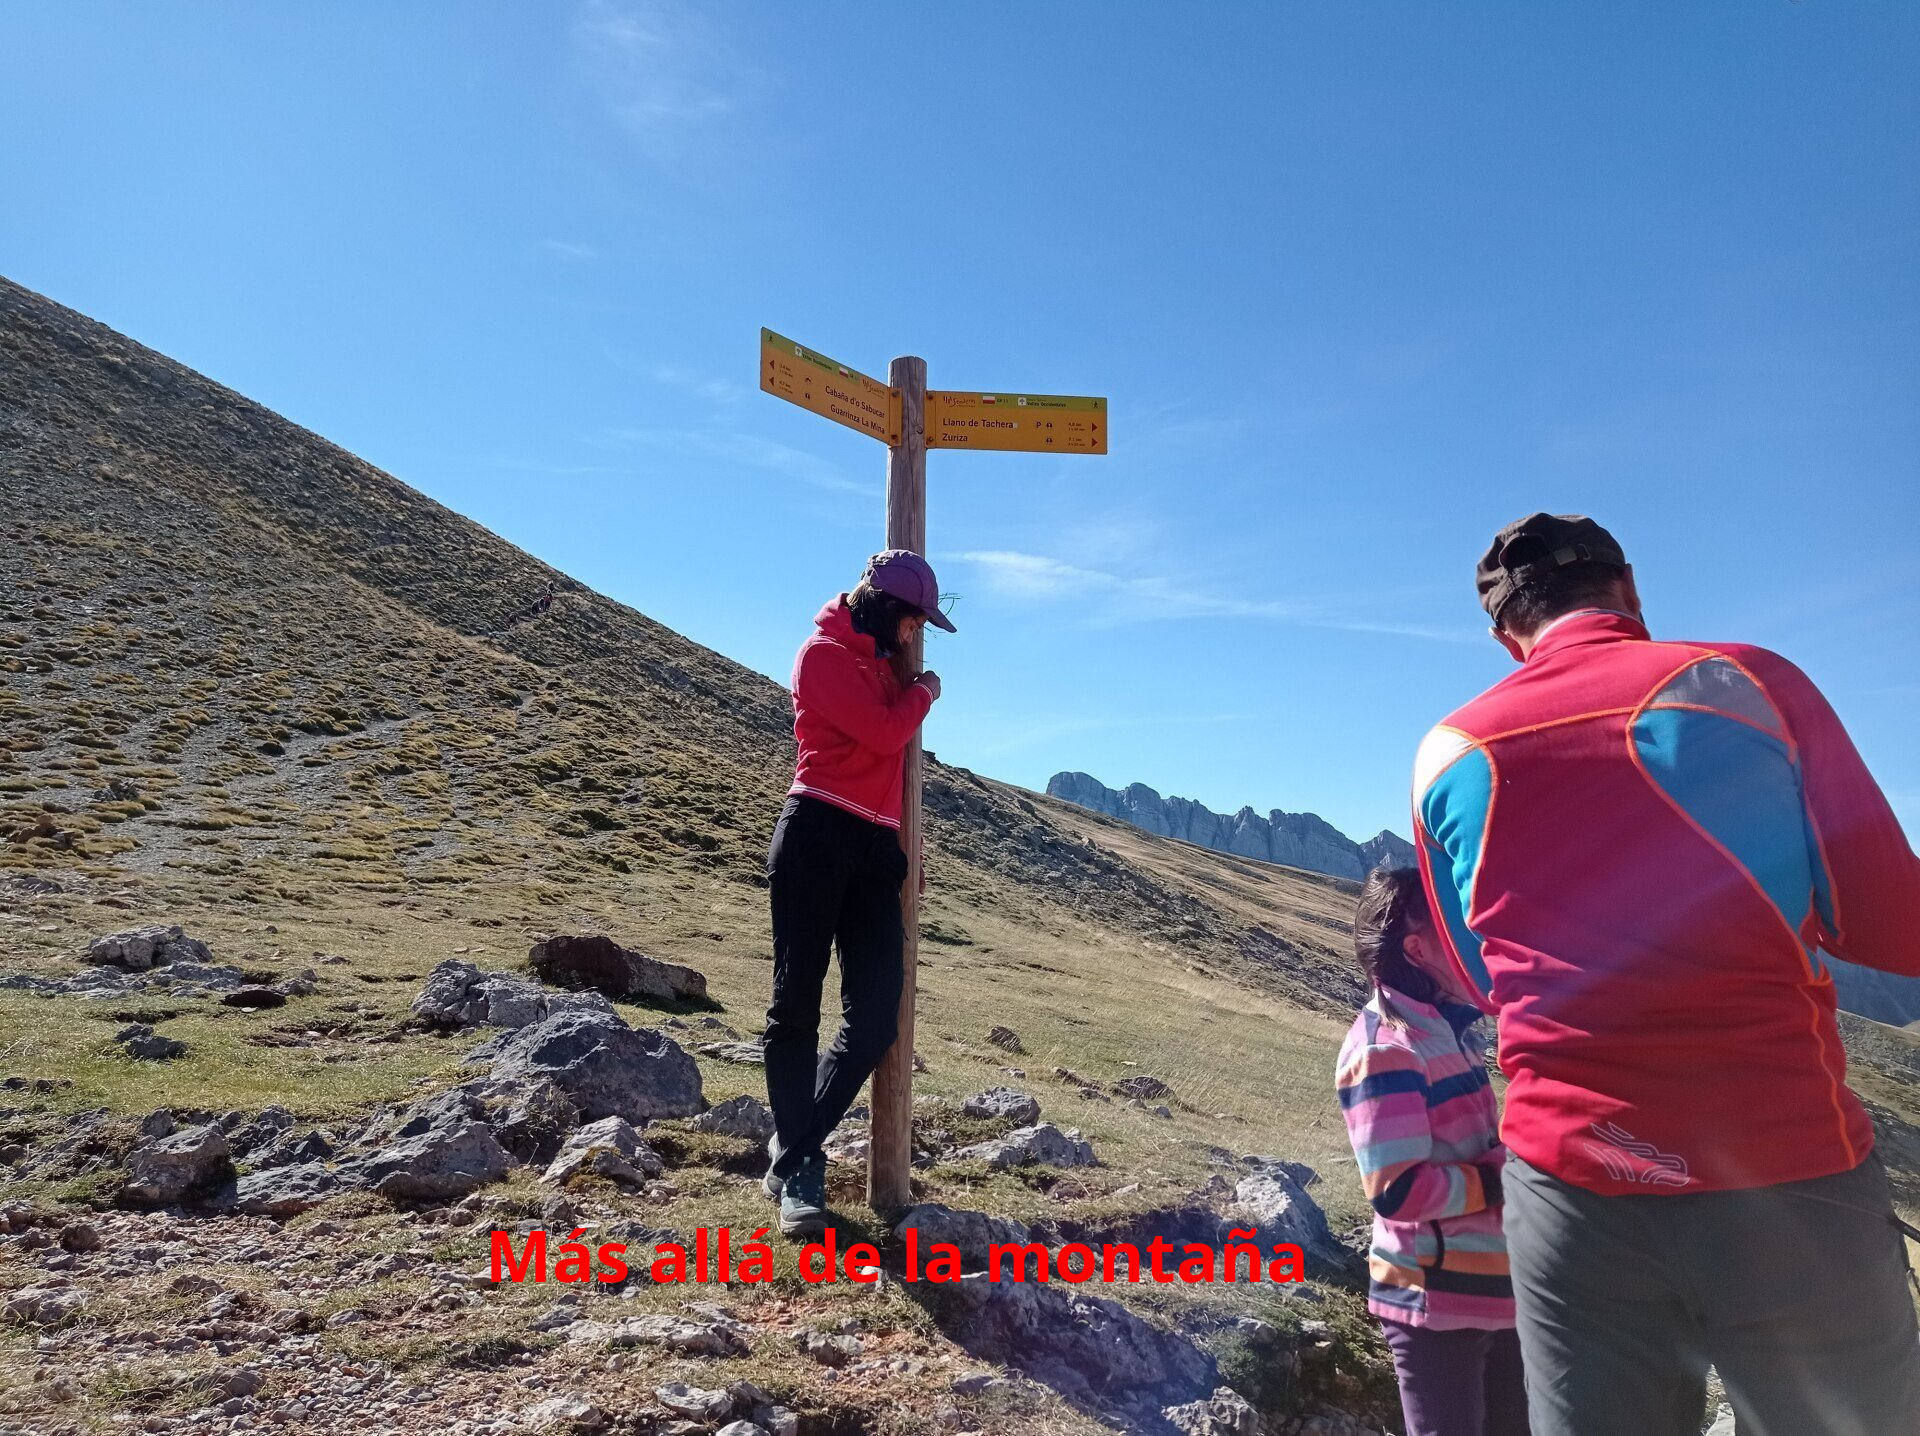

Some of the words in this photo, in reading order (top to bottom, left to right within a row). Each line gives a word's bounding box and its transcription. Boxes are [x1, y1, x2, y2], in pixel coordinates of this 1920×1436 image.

[825, 385, 849, 403] Cabaña
[861, 401, 885, 419] Sabucar
[830, 404, 860, 424] Guarrinza
[861, 417, 869, 427] La
[870, 421, 885, 434] Mina
[943, 418, 966, 427] Llano
[968, 418, 978, 427] de
[942, 432, 968, 442] Zuriza
